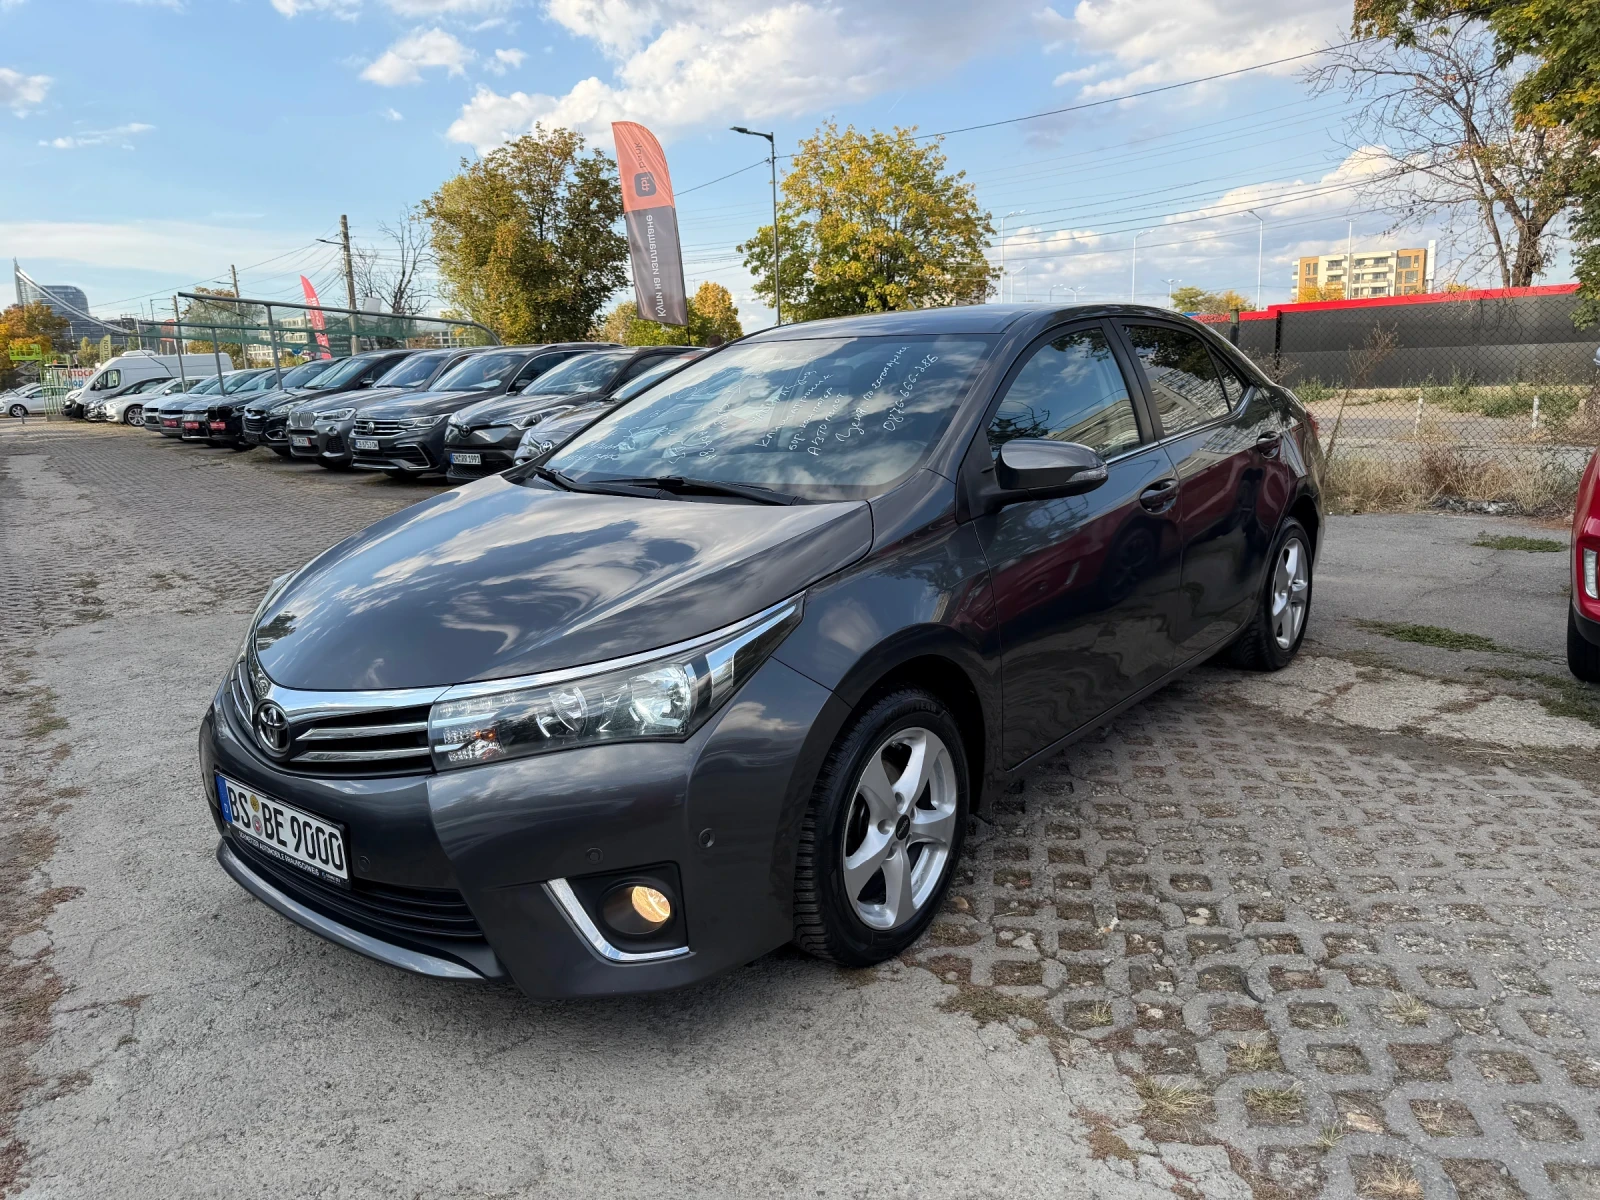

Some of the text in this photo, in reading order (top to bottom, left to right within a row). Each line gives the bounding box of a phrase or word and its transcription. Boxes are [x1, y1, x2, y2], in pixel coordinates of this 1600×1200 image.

[227, 786, 344, 871] BS BE 9000
